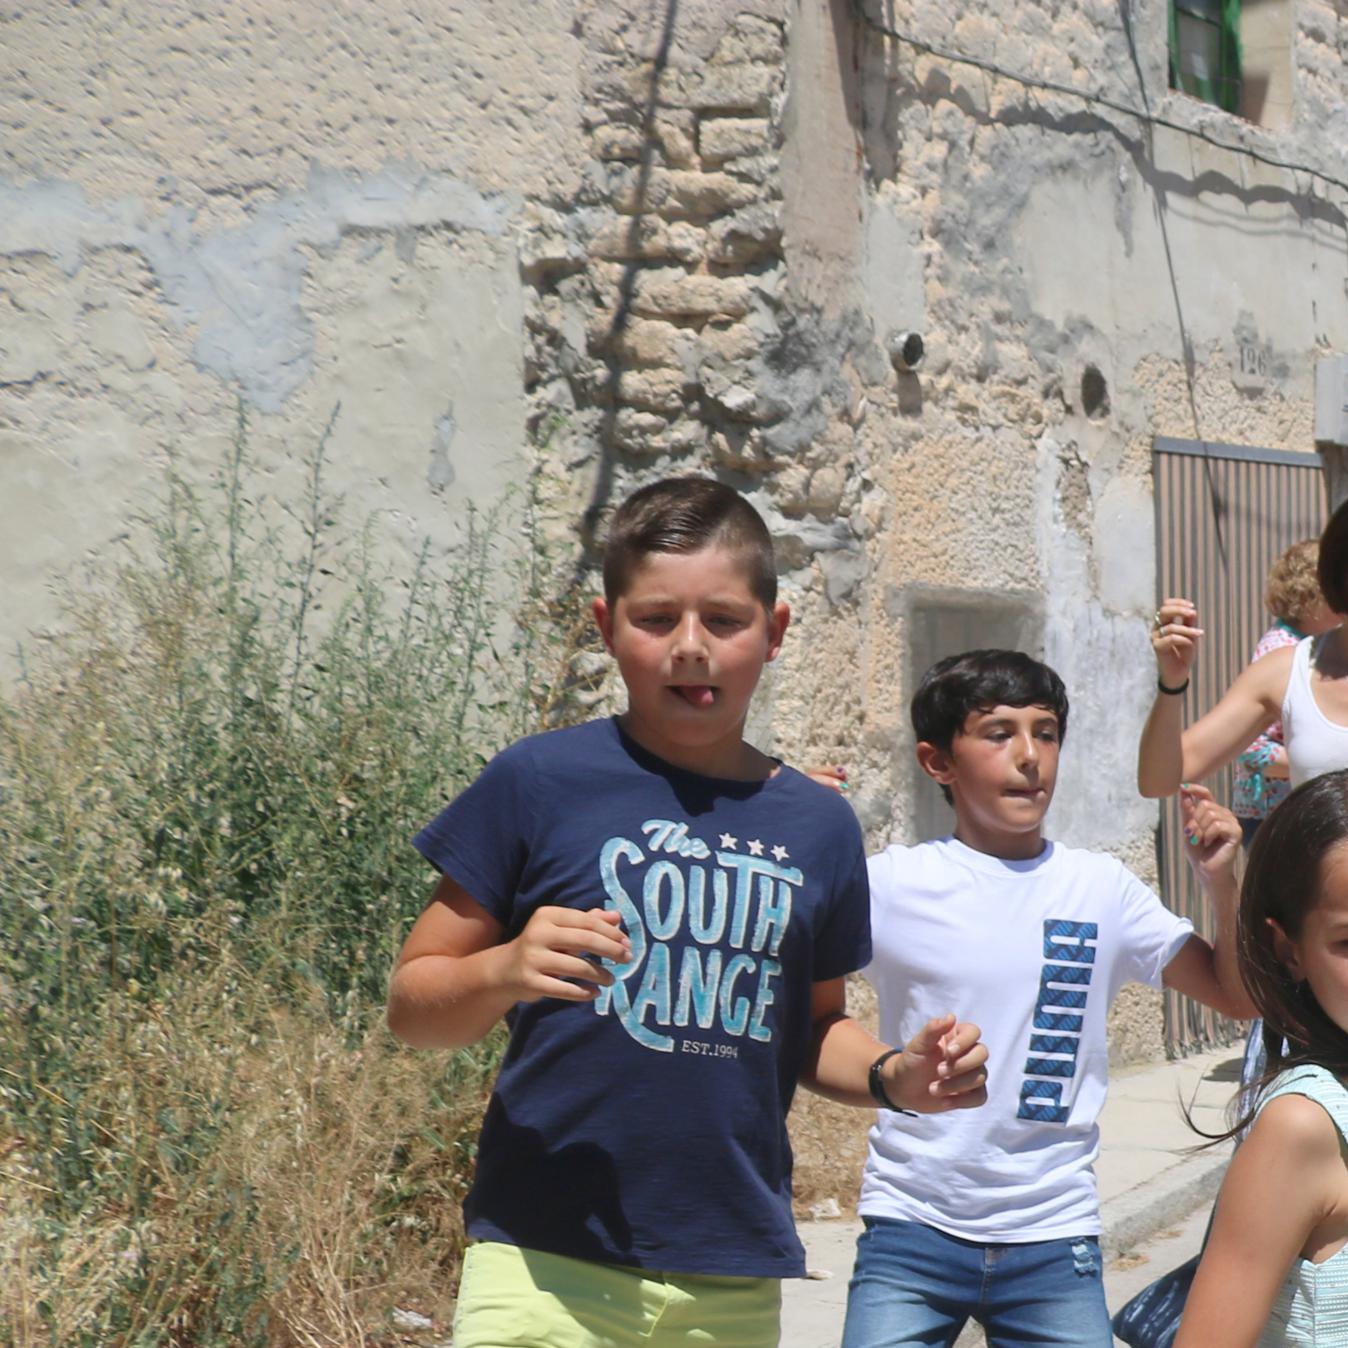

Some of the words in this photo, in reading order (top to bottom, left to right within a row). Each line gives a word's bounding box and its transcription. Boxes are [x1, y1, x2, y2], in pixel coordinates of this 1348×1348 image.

[641, 819, 711, 860] The
[599, 837, 804, 980] SOUTH
[594, 942, 782, 1053] RANGE
[681, 1039, 738, 1059] EST.1994
[1016, 918, 1099, 1123] PUMA
